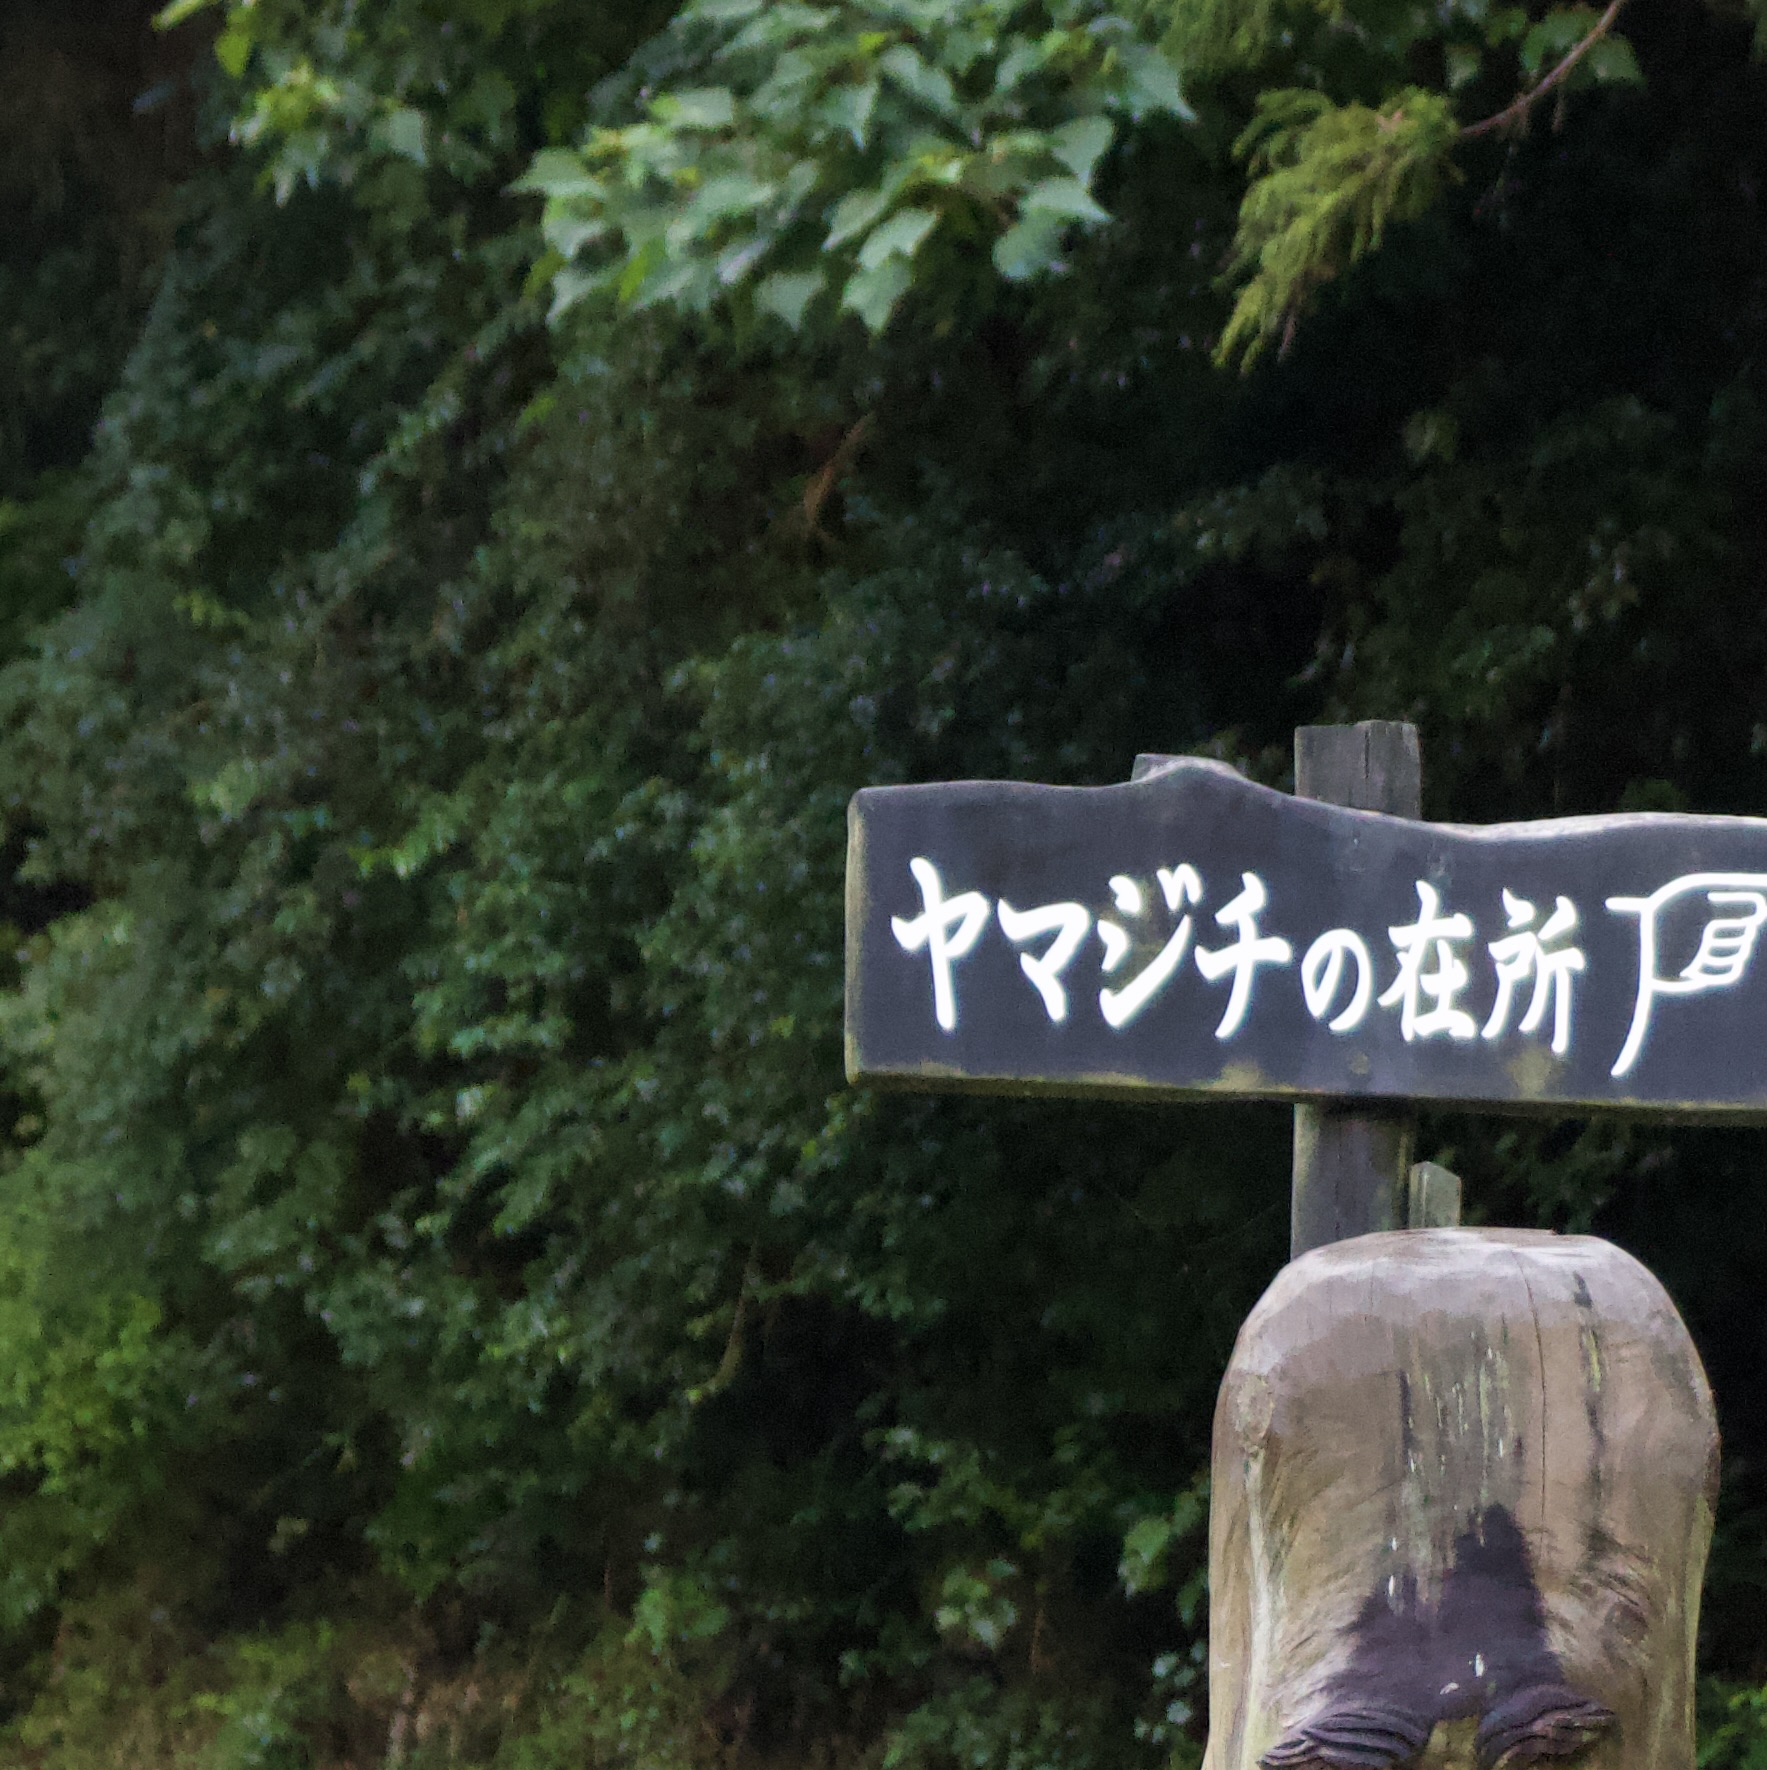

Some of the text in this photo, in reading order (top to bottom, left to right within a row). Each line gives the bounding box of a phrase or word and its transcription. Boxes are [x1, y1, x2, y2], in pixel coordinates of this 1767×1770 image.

[890, 856, 1587, 1056] ヤマジチの在所
